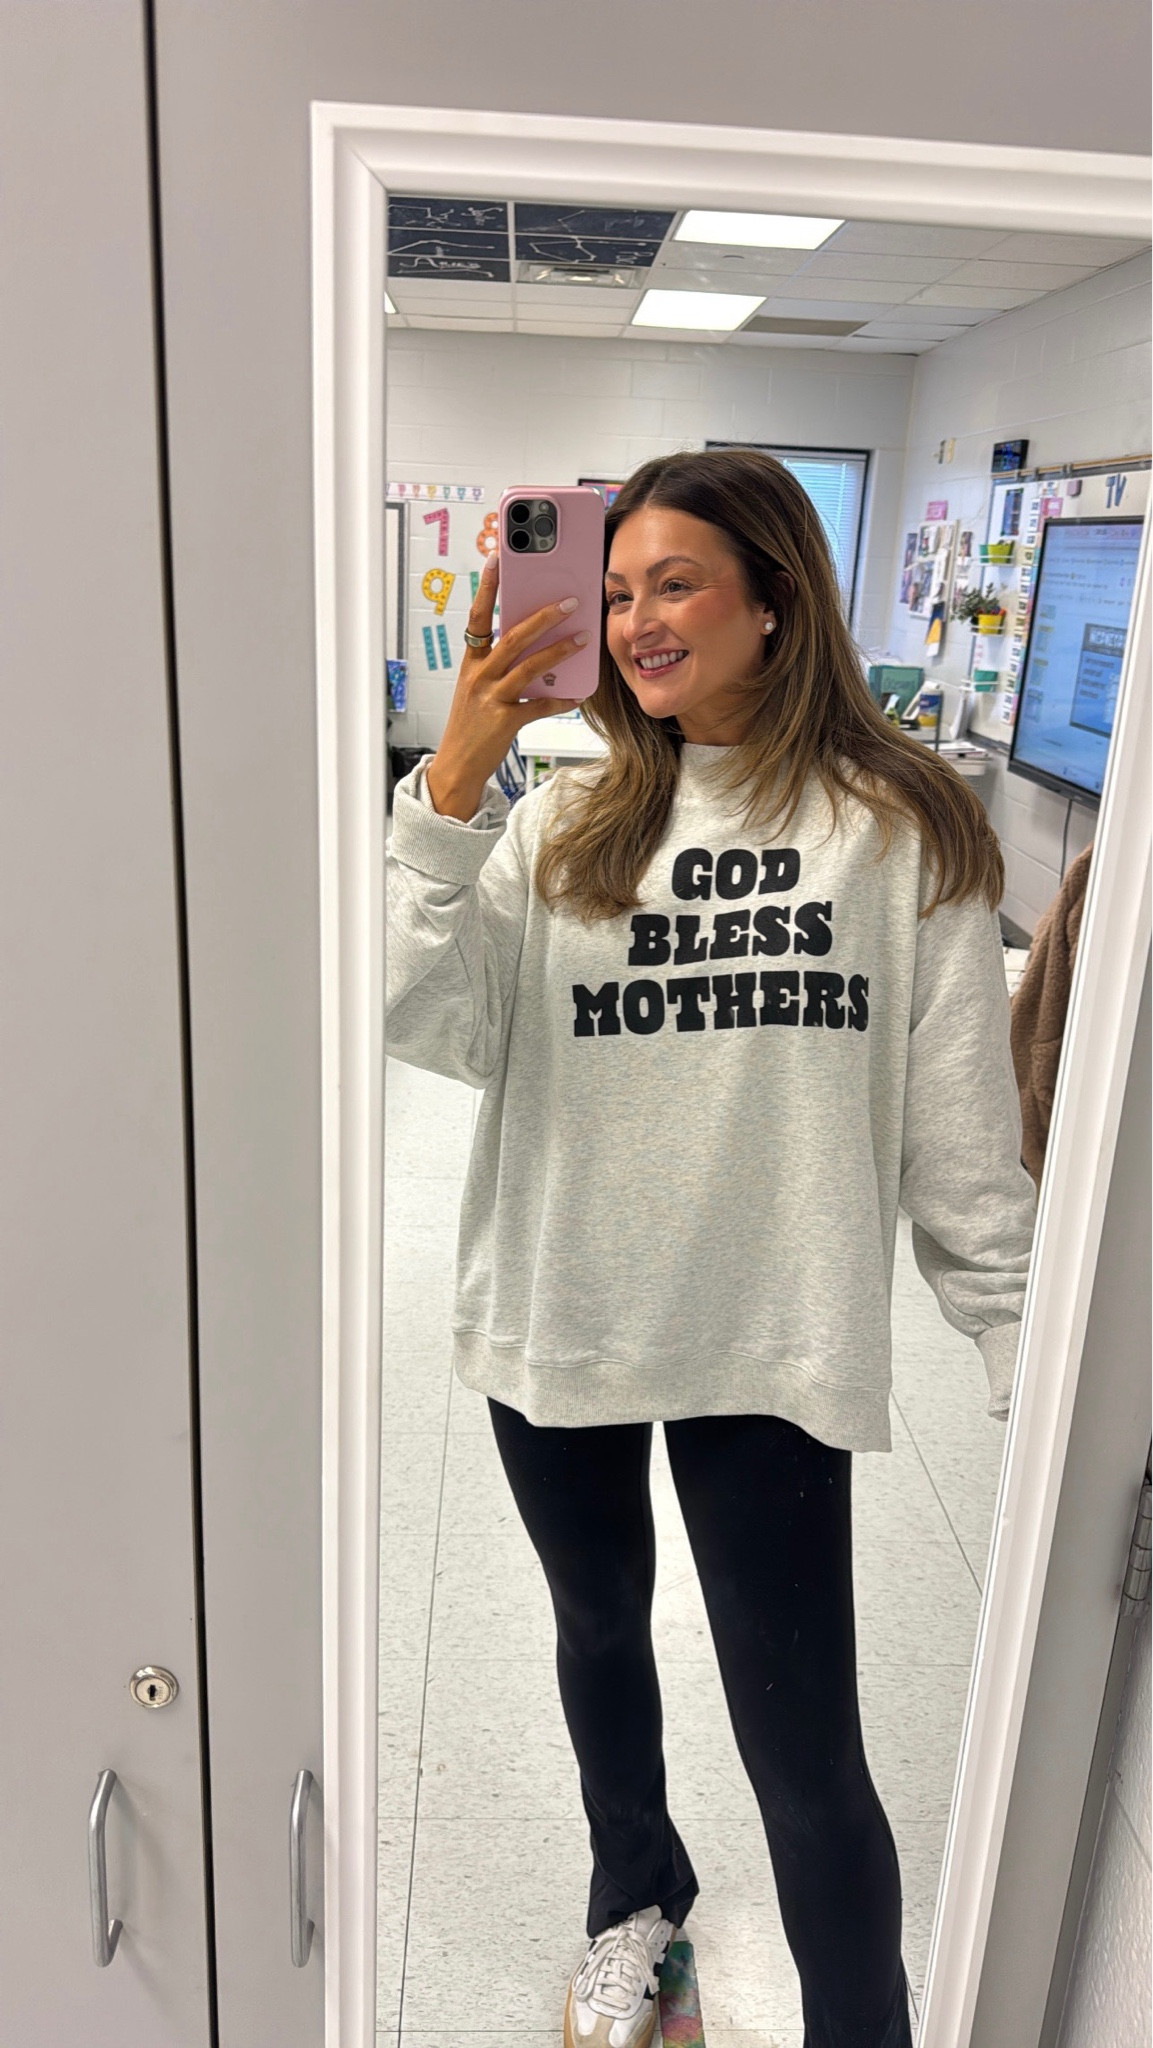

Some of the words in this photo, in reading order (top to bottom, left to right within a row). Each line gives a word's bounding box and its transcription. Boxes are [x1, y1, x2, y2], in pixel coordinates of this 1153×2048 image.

[422, 568, 456, 616] 9
[671, 847, 801, 901] GOD
[628, 900, 833, 967] BLESS
[572, 970, 870, 1038] MOTHERS
